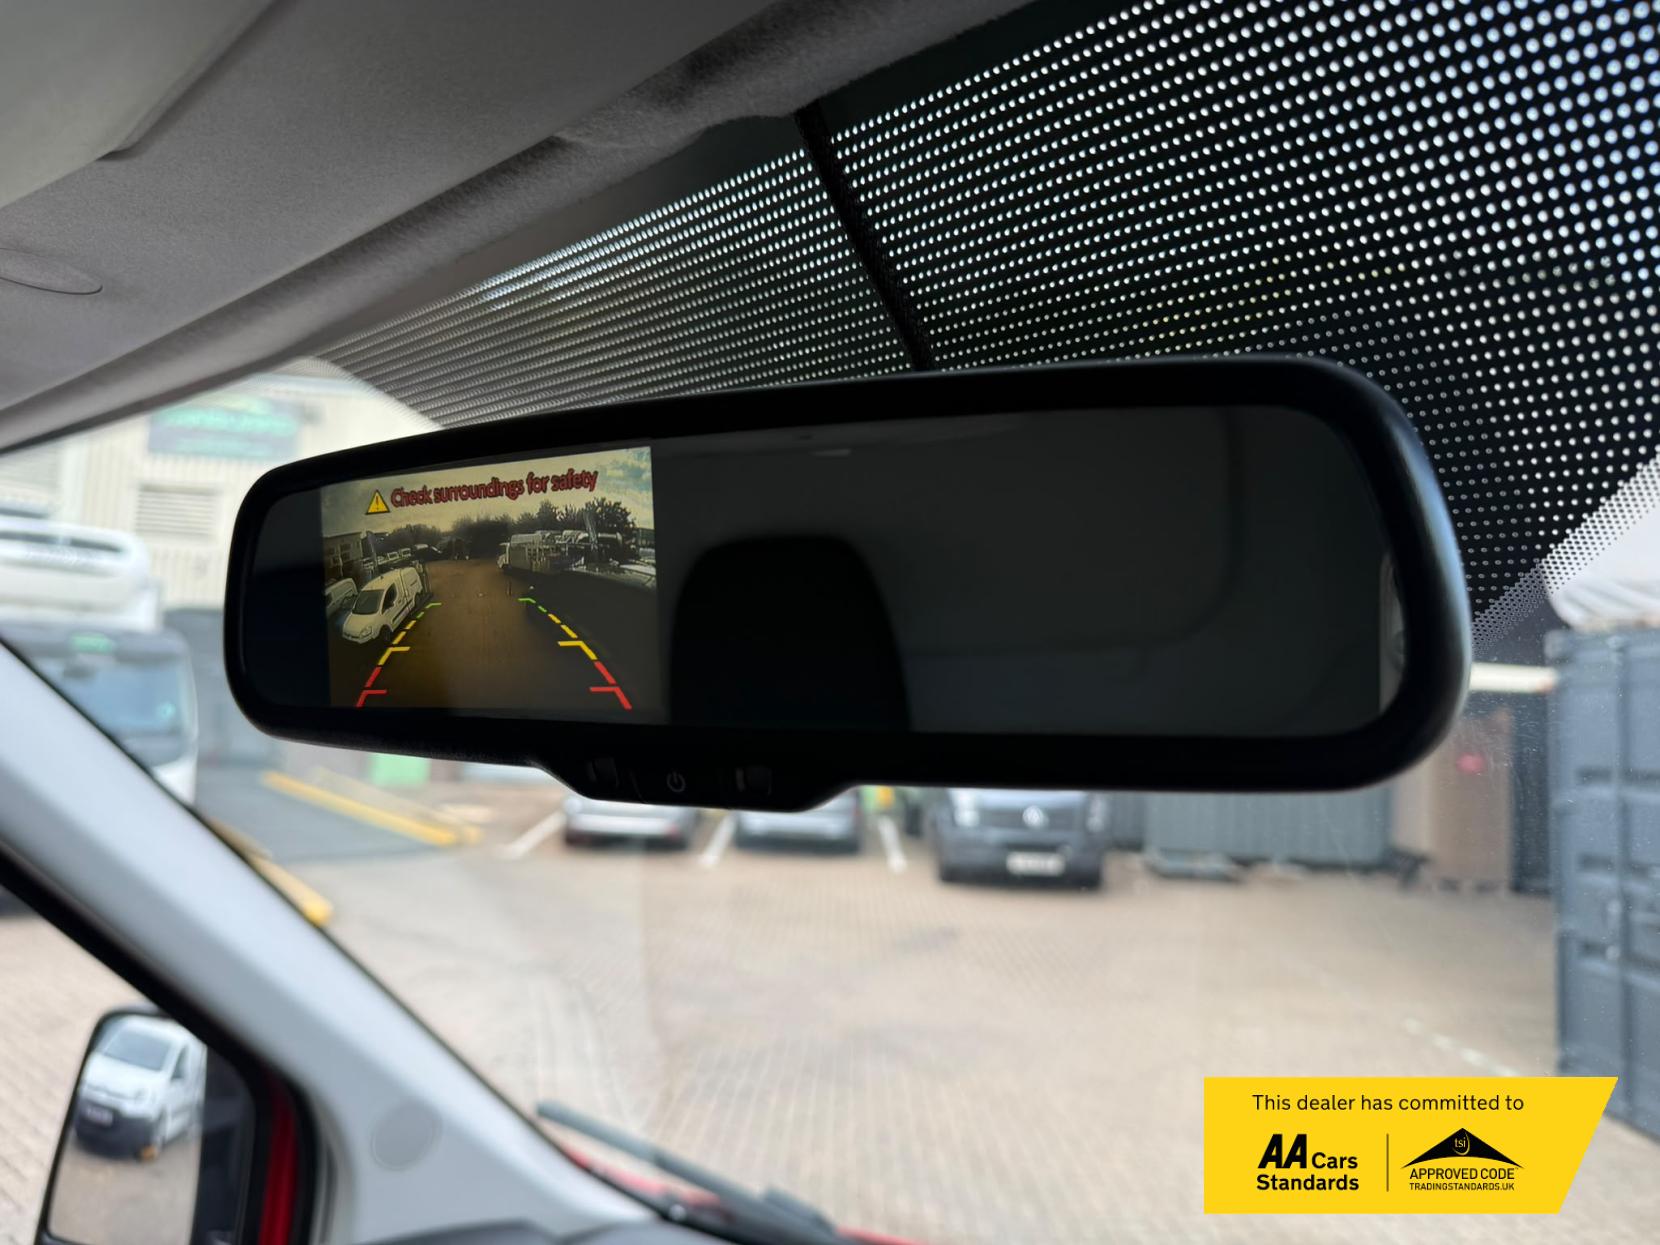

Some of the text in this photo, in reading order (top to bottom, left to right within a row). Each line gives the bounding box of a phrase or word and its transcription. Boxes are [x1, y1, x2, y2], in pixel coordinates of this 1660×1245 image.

[391, 468, 599, 508] Check surroundings for safety
